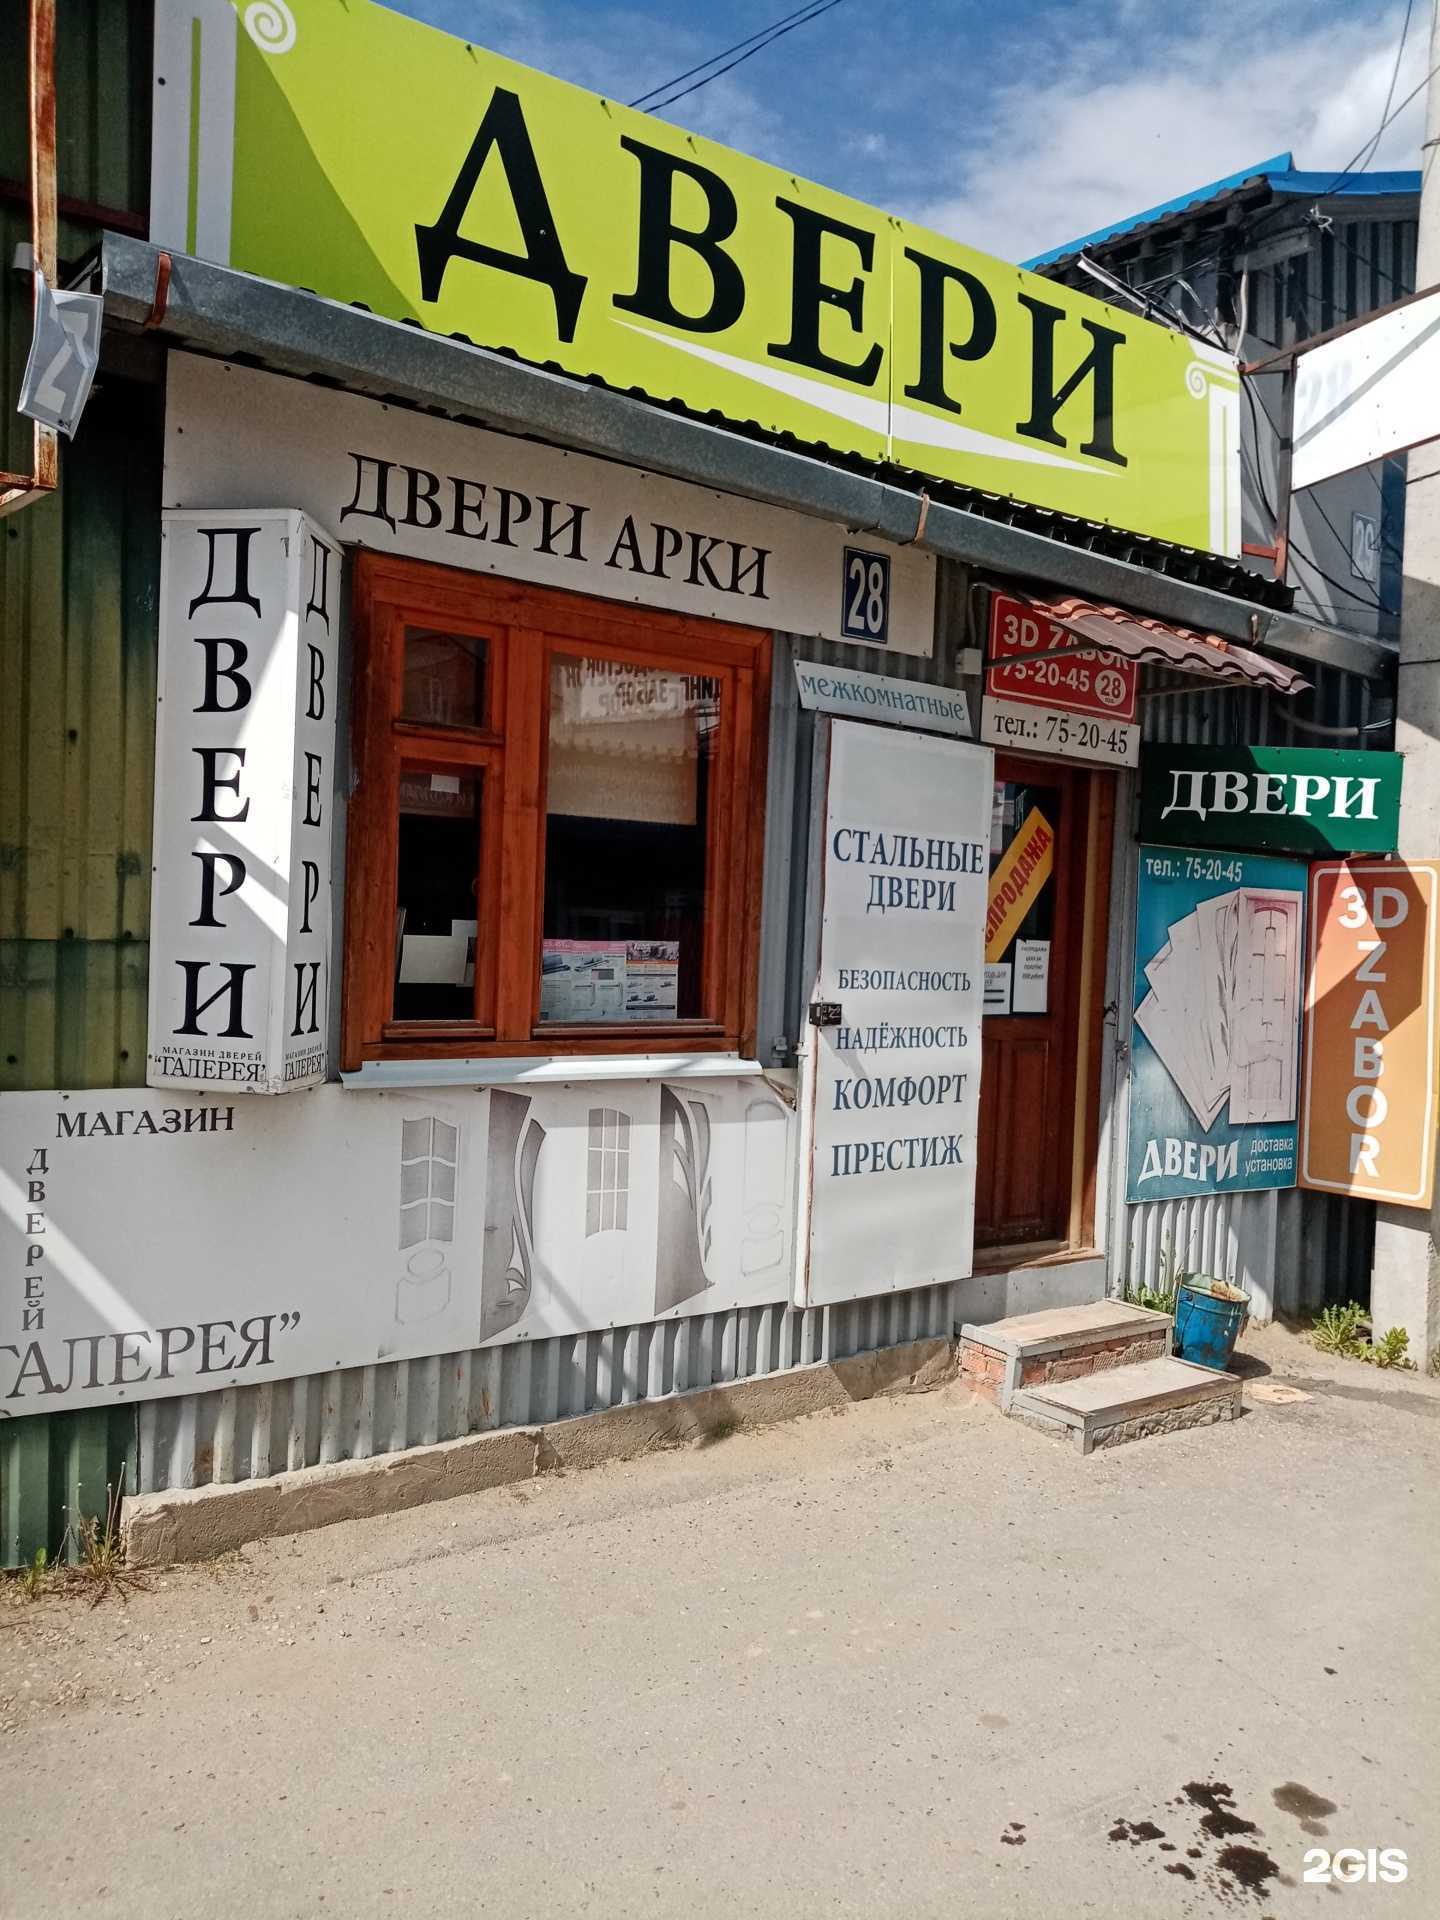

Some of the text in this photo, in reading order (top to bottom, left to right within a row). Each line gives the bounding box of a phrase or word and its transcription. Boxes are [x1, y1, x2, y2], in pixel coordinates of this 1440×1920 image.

[415, 86, 1127, 467] ДВЕРИ
[340, 452, 772, 600] ДВЕРИ АРКИ
[848, 557, 885, 640] 28
[1003, 614, 1039, 648] 3D
[1002, 653, 1090, 692] 75-20-45
[1100, 674, 1121, 699] 28
[801, 674, 965, 720] межкомнатные
[994, 714, 1128, 754] тел.: 75-20-45
[172, 527, 262, 1039] ДВЕРИ
[290, 534, 331, 1036] ДВЕРИ
[1161, 770, 1381, 821] ДВЕРИ
[833, 828, 984, 874] СТАЛЬНЫЕ
[1146, 857, 1243, 882] тел.: 75-20-45
[867, 874, 956, 914] ДВЕРИ
[1337, 886, 1408, 929] 3D
[838, 968, 971, 993] БЕЗОПАСНОСТЬ
[162, 1046, 262, 1061] МАГАЗИН ДВЕРЕЙ
[836, 1020, 968, 1053] НАДЁЖНОСТЬ
[1346, 940, 1389, 1178] ZABOR
[833, 1074, 967, 1112] КОМФОРТ
[55, 1106, 235, 1138] МАГАЗИН
[831, 1133, 963, 1178] ПРЕСТИЖ
[1138, 1137, 1294, 1187] ДВЕРИ доставка
[1245, 1156, 1293, 1177] установка
[22, 1148, 49, 1331] ДВЕРЕЙ
